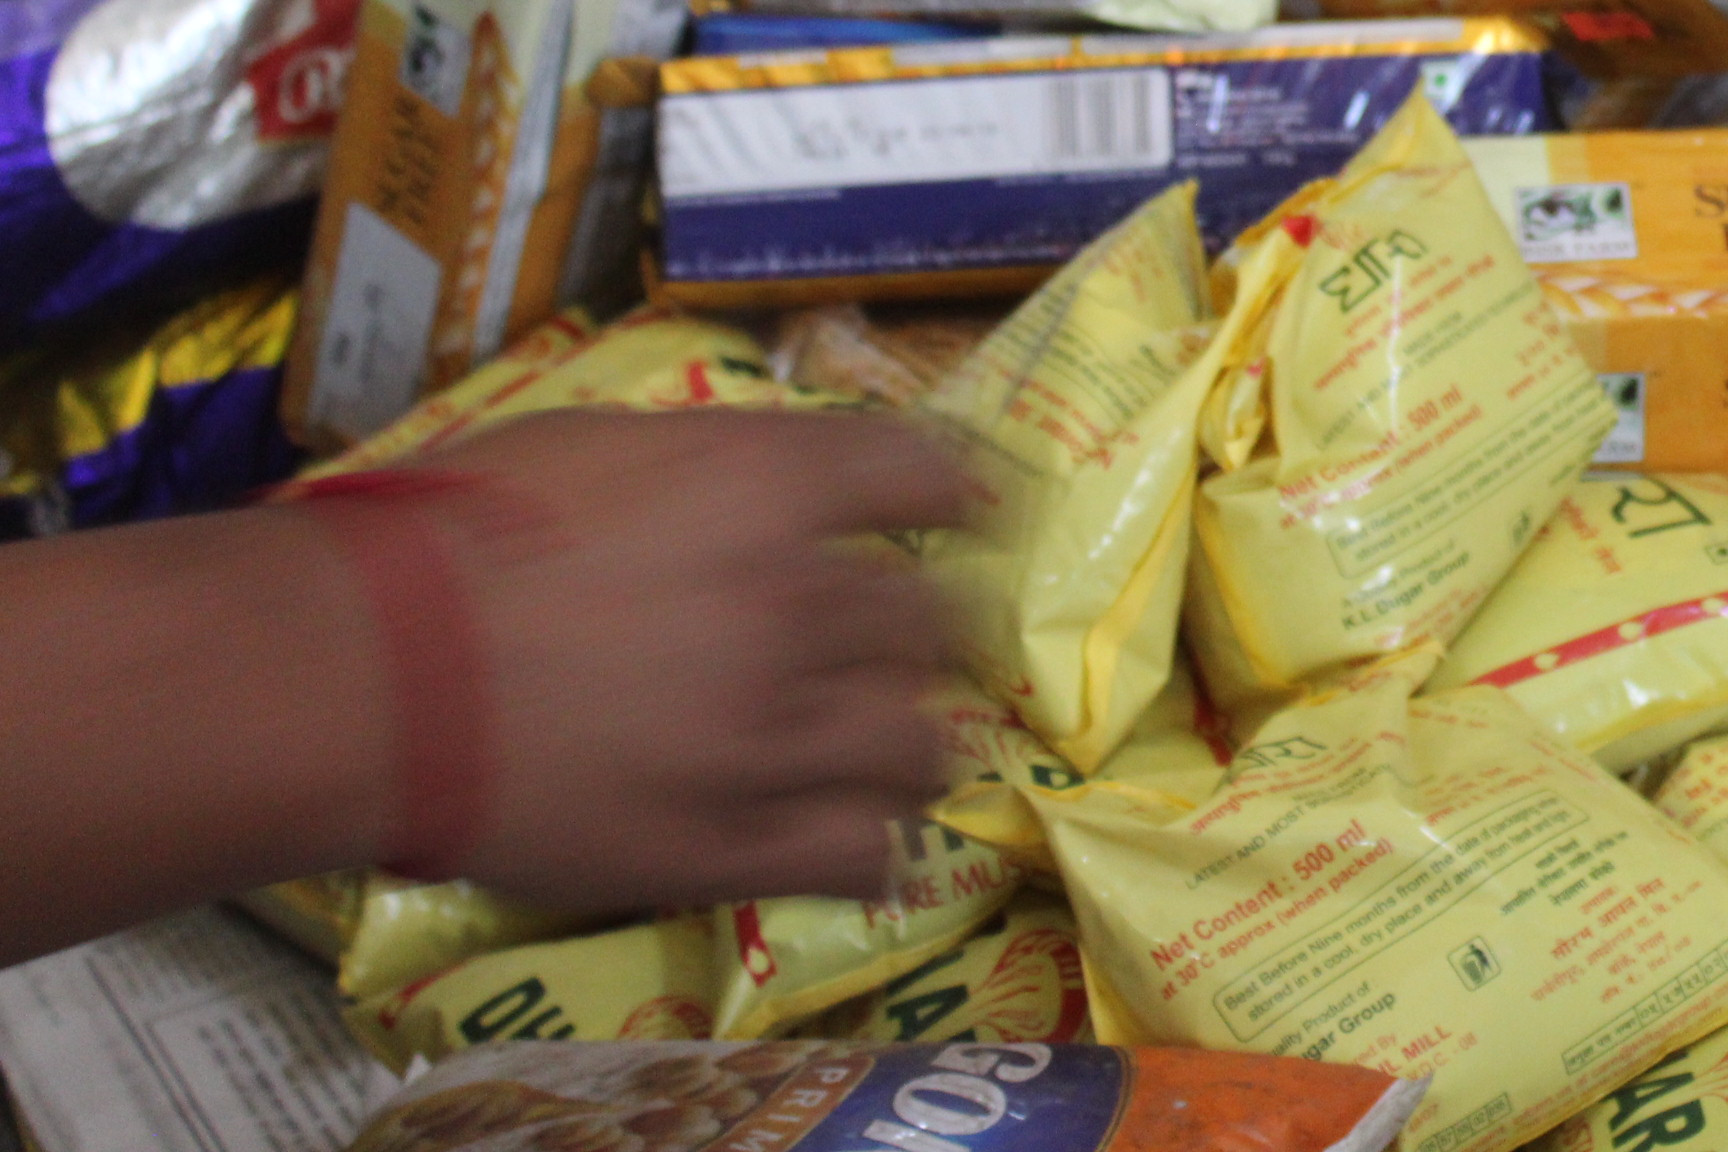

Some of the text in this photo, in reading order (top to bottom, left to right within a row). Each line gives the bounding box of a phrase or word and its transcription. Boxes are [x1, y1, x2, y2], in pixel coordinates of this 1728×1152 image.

[1235, 835, 1267, 861] AND
[1264, 804, 1306, 841] MOST
[1150, 932, 1196, 972] Net
[1192, 880, 1284, 941] Content
[1291, 841, 1337, 882] 500
[1335, 817, 1367, 853] ml
[1216, 918, 1277, 961] approx
[1276, 884, 1330, 928] (when
[1327, 834, 1397, 895] packed)
[1222, 979, 1260, 1012] Best
[1258, 949, 1310, 987] Before
[1308, 928, 1344, 957] Nine
[1343, 894, 1399, 936] months
[1394, 870, 1432, 900] from
[1430, 852, 1455, 876] the
[1453, 833, 1482, 859] date
[1248, 982, 1294, 1023] stored
[1293, 970, 1311, 989] in
[1312, 965, 1324, 979] a
[1358, 928, 1385, 949] dry
[1383, 901, 1424, 936] place
[1422, 878, 1454, 906] and
[1452, 855, 1489, 888] away
[1301, 979, 1372, 1036] Product of
[1336, 991, 1397, 1035] Group
[1401, 1023, 1454, 1062] MILL
